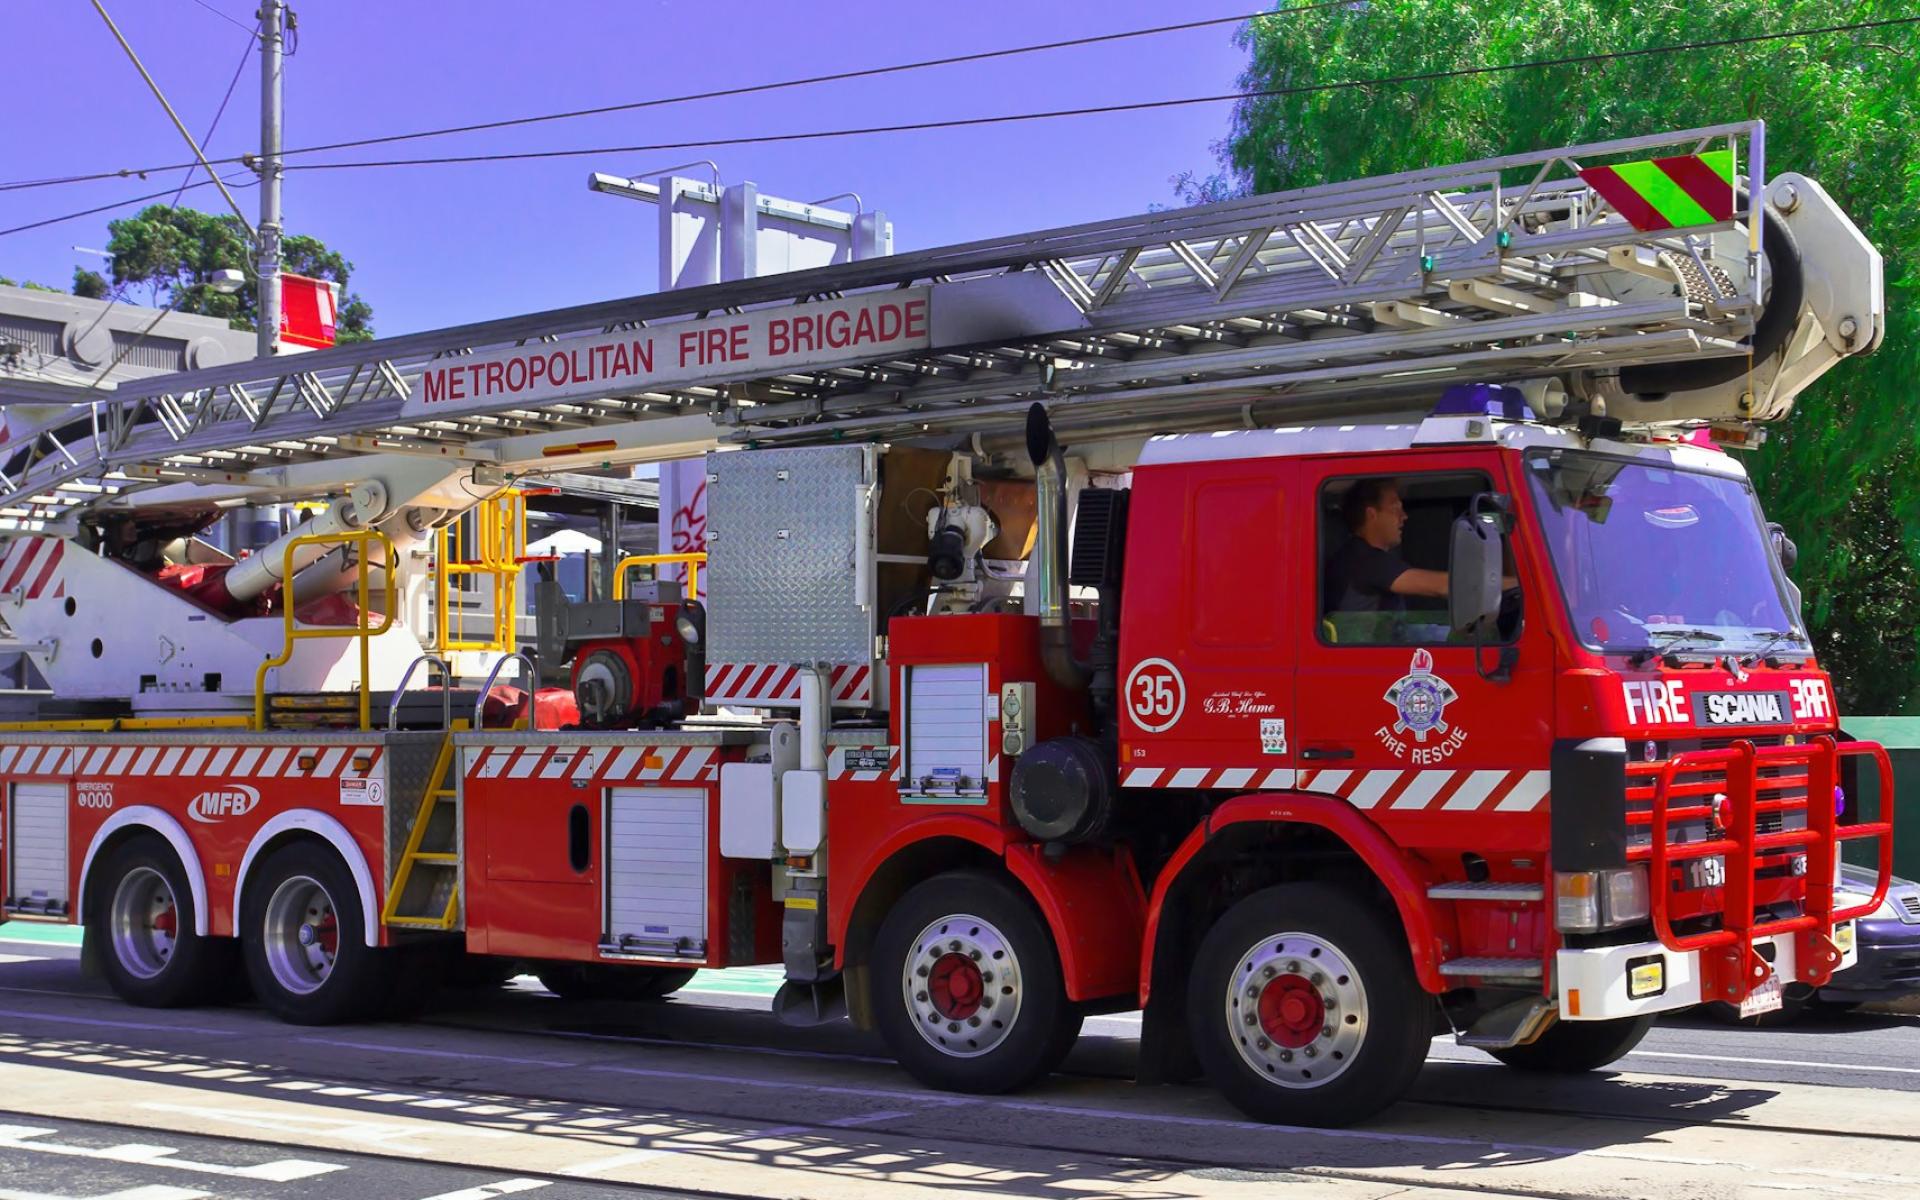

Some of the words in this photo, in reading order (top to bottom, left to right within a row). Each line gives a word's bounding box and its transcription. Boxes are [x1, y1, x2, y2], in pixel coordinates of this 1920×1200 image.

[424, 338, 653, 403] METROPOLITAN
[679, 324, 750, 368] FIRE
[768, 299, 926, 356] BRIGADE
[1136, 674, 1174, 716] 35
[1235, 698, 1276, 714] Hume
[1622, 680, 1689, 725] FIRE
[1707, 694, 1782, 724] SCANIA
[1374, 726, 1407, 758] FIRE
[1411, 726, 1468, 765] RESCUE
[87, 792, 113, 808] 000
[201, 792, 247, 816] MFB
